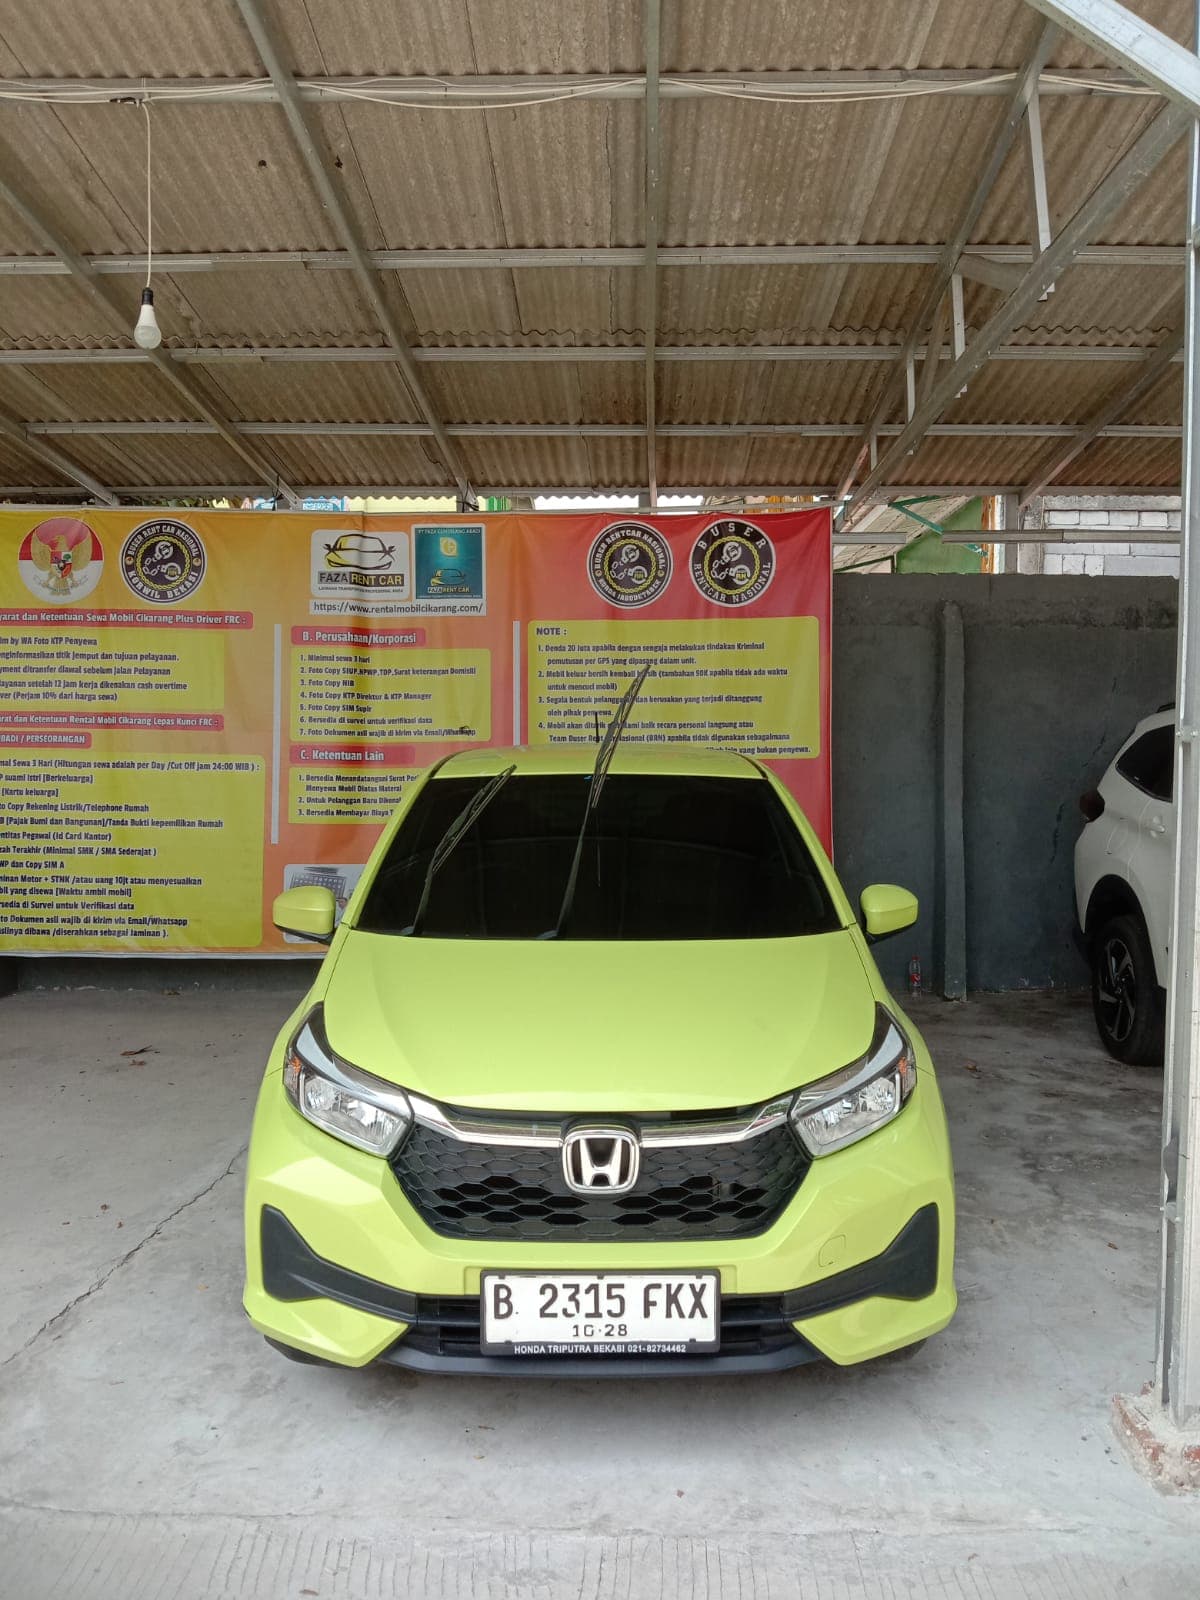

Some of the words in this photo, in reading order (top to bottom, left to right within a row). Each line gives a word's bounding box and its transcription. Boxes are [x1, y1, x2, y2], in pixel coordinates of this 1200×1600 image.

[143, 525, 160, 539] RENT
[162, 525, 175, 534] CAR
[176, 528, 200, 556] NASIONAL
[697, 522, 768, 550] BUSER
[606, 529, 641, 546] RENTCAR
[642, 533, 666, 569] NASIONAL
[319, 573, 348, 583] FAZA
[351, 574, 376, 586] RENT
[380, 575, 403, 585] CAR
[694, 563, 727, 602] RENTCAR
[732, 562, 771, 604] NASIONAL
[128, 570, 160, 599] KORWIL
[166, 571, 200, 599] BEKASI
[314, 602, 483, 614] https://www.rentalmobilcikarang.com/
[22, 612, 38, 621] dan
[40, 612, 84, 622] Ketentuan
[87, 614, 107, 622] Sewa
[109, 613, 133, 622] Mobil
[136, 614, 173, 624] Cikarang
[176, 615, 194, 623] Plus
[196, 615, 222, 624] Driver
[225, 616, 240, 624] FRC
[536, 627, 561, 636] NOTE
[34, 637, 49, 645] Foto
[51, 637, 63, 645] KTP
[65, 637, 97, 646] Penyewa
[316, 632, 416, 645] Perusahaan/Korporasi
[592, 645, 616, 654] apabila
[617, 645, 641, 653] dengan
[642, 645, 667, 653] sengaja
[669, 644, 705, 652] melakukan
[706, 643, 735, 651] tindakan
[737, 642, 764, 650] Kriminal
[72, 651, 98, 661] jemput
[101, 652, 113, 660] dan
[115, 652, 138, 661] tujuan
[140, 652, 179, 662] pelayanan.
[547, 658, 583, 666] pemutusan
[612, 658, 627, 666] yang
[628, 658, 658, 666] dipasang
[659, 657, 680, 665] dalam
[84, 666, 112, 674] sebelum
[114, 667, 132, 676] jalan
[134, 667, 171, 676] Pelayanan
[325, 668, 340, 676] Copy
[546, 670, 564, 678] Mobil
[710, 669, 733, 678] apabila
[735, 668, 752, 676] tidak
[767, 668, 787, 676] waktu
[63, 681, 77, 689] jam
[79, 681, 98, 690] kerja
[100, 681, 135, 689] dikenakan
[137, 681, 153, 689] cash
[155, 682, 188, 690] overtime
[325, 680, 340, 688] Copy
[568, 683, 594, 691] mencuci
[59, 692, 73, 700] dari
[75, 692, 97, 702] harga
[98, 693, 118, 702] sewa)
[325, 692, 341, 700] Copy
[404, 693, 432, 701] Manager
[546, 696, 568, 705] Segala
[684, 696, 700, 704] yang
[701, 695, 723, 704] terjadi
[725, 695, 762, 704] ditanggung
[324, 704, 340, 712] Copy
[563, 709, 581, 718] pihak
[30, 715, 68, 723] Ketentuan
[70, 715, 95, 723] Rental
[98, 716, 117, 724] Mobil
[119, 717, 152, 726] Cikarang
[154, 718, 175, 726] Lepas
[678, 721, 706, 730] personal
[707, 720, 737, 729] langsung
[738, 720, 754, 728] atau
[324, 728, 355, 736] Dokumen
[692, 734, 710, 742] tidak
[711, 734, 745, 742] digunakan
[757, 746, 777, 754] bukan
[312, 749, 363, 761] Ketentuan
[365, 750, 384, 761] Lain
[55, 760, 91, 769] (Hitungan
[112, 761, 135, 769] adalah
[151, 762, 165, 770] Day
[213, 762, 233, 770] 24:00
[306, 785, 336, 793] Menyewa
[328, 797, 360, 806] Pelanggan
[8, 803, 24, 811] Copy
[335, 809, 370, 818] Membayar
[66, 832, 82, 840] Card
[13, 847, 41, 855] Terakhir
[119, 848, 151, 856] Sederajat
[26, 861, 42, 870] Copy
[44, 861, 57, 869] SIM
[21, 875, 42, 883] Motor
[130, 877, 146, 885] atau
[11, 888, 27, 896] yang
[29, 887, 54, 895] disewa
[85, 888, 107, 896] ambil
[56, 902, 78, 910] untuk
[119, 902, 134, 910] data
[10, 916, 44, 924] Dokumen
[61, 917, 81, 925] wajib
[493, 1283, 513, 1319] B
[539, 1283, 626, 1318] 2315
[643, 1283, 709, 1319] FKX
[514, 1344, 546, 1354] HONDA
[548, 1344, 591, 1353] TRIPUTRA
[593, 1344, 625, 1353] BEKASI
